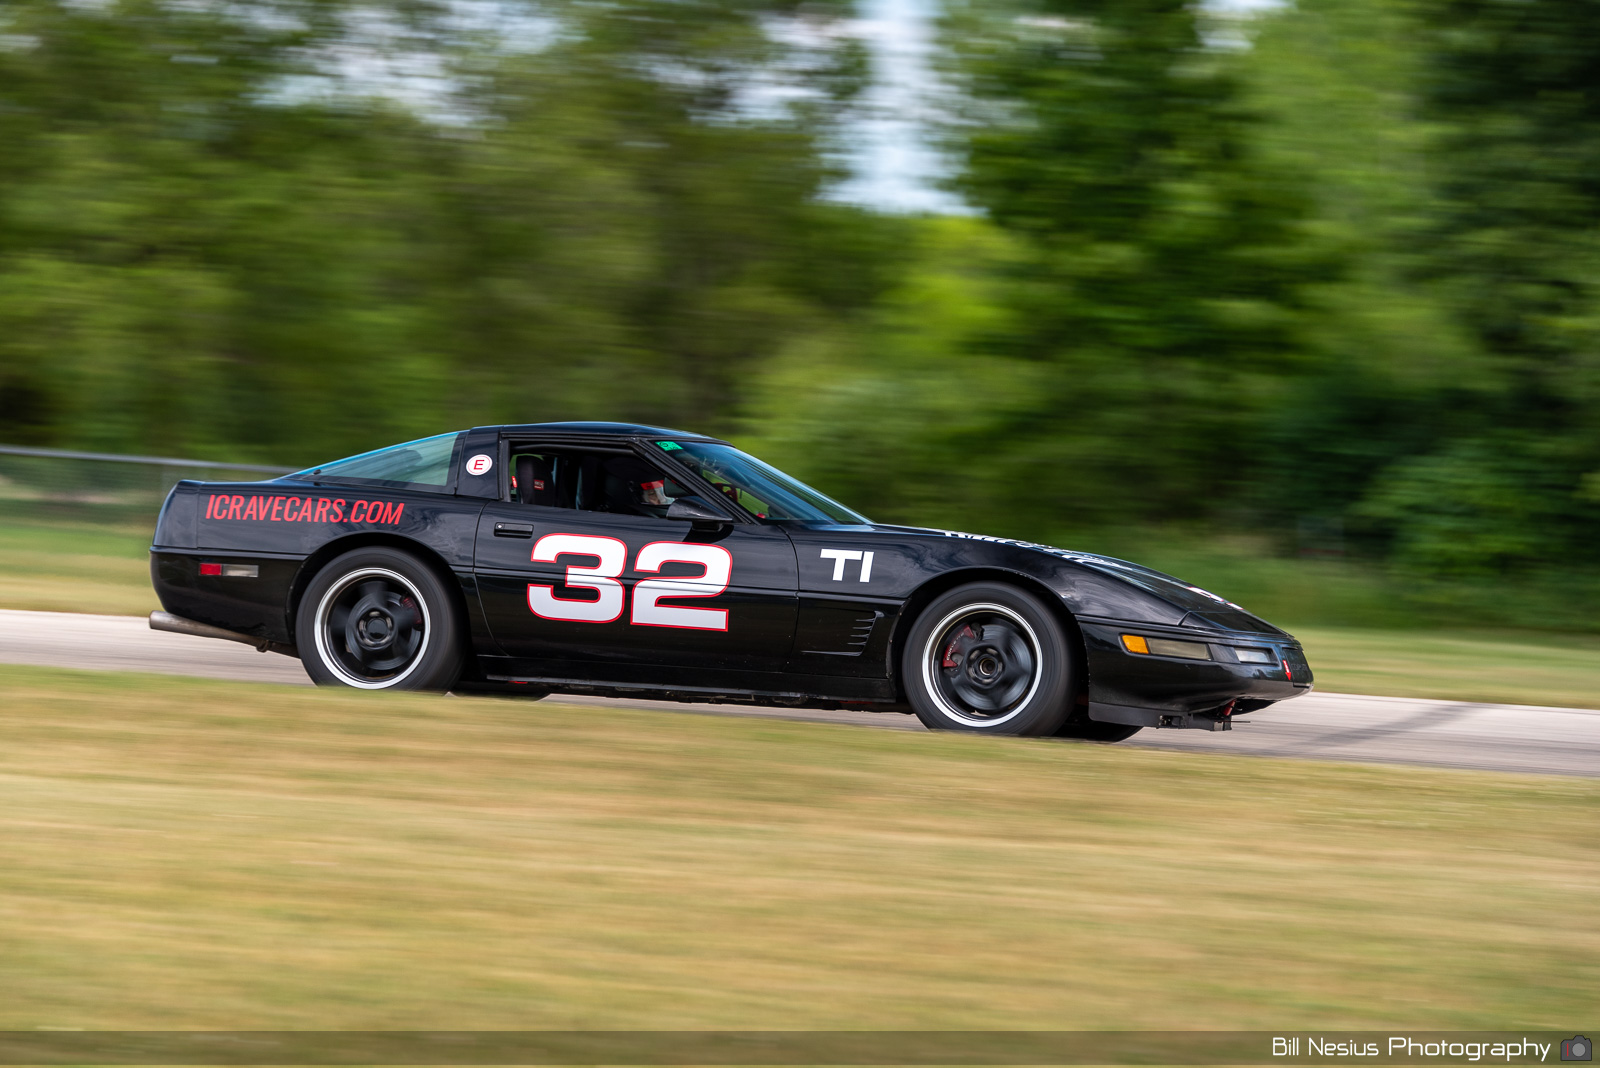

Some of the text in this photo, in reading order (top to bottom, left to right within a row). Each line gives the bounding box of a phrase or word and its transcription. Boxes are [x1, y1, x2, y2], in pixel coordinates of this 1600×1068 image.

[473, 459, 485, 470] E
[205, 494, 405, 526] ICRAVECARS.COM
[527, 533, 733, 632] 32
